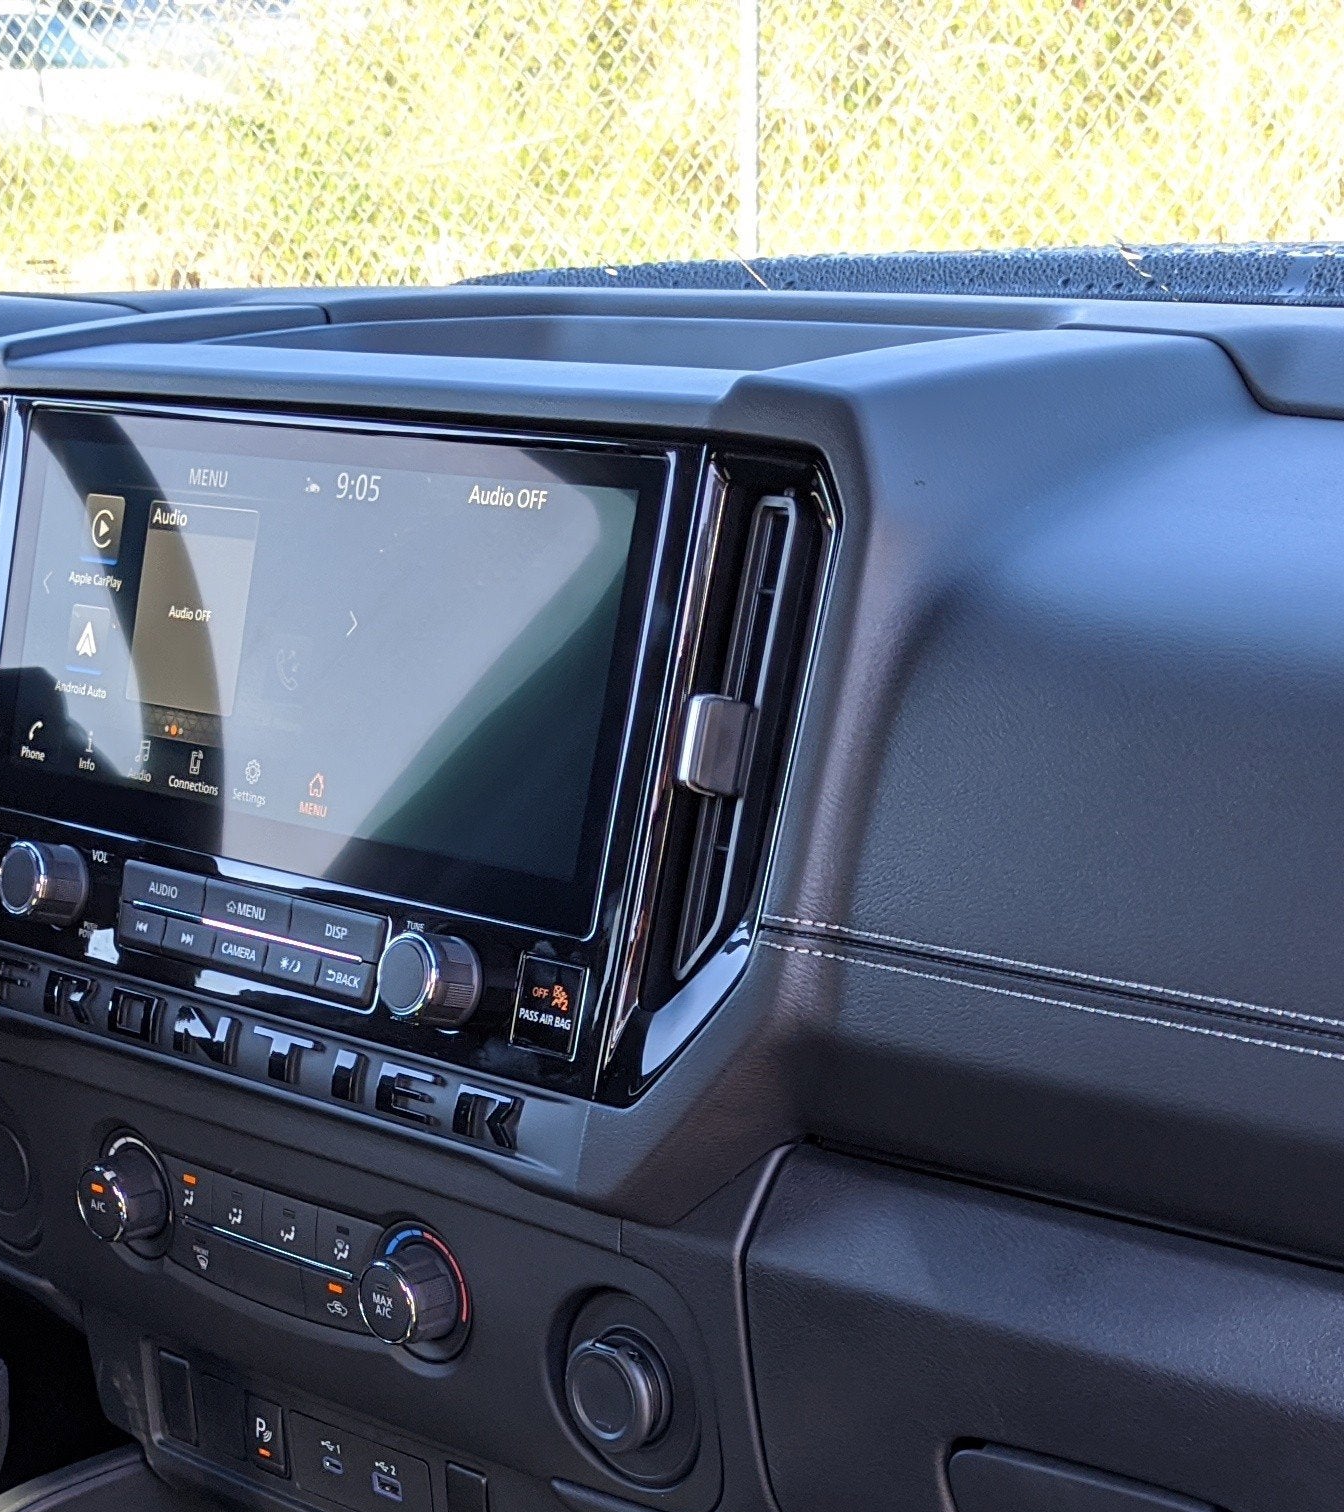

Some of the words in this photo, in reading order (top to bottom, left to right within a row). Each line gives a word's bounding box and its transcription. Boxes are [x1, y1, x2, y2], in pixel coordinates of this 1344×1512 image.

[189, 468, 229, 488] MENU
[334, 472, 381, 502] 9:05
[468, 484, 514, 509] Audio
[517, 486, 549, 511] OFF
[152, 507, 188, 527] Audio
[69, 571, 92, 587] Apple
[93, 574, 123, 592] CarPlay
[168, 605, 194, 621] Audio
[195, 608, 212, 622] OFF
[55, 680, 85, 697] Android
[86, 684, 107, 699] Auto
[20, 745, 45, 762] Phone
[79, 757, 95, 772] Info
[127, 768, 152, 783] Audio
[168, 775, 219, 796] Connections
[233, 788, 266, 808] Settings
[299, 801, 328, 818] MENU
[92, 849, 108, 864] VOL
[148, 881, 178, 899] AUDIO
[236, 903, 267, 921] MENU
[324, 923, 348, 940] DISP
[221, 942, 256, 962] CAMERA
[335, 971, 362, 989] BACK
[532, 986, 549, 999] OFF
[519, 1007, 538, 1023] PASS
[539, 1012, 553, 1026] AIR
[554, 1016, 572, 1031] BAG
[90, 1198, 106, 1214] A/C
[372, 1292, 393, 1309] MAX
[375, 1305, 392, 1319] A/C
